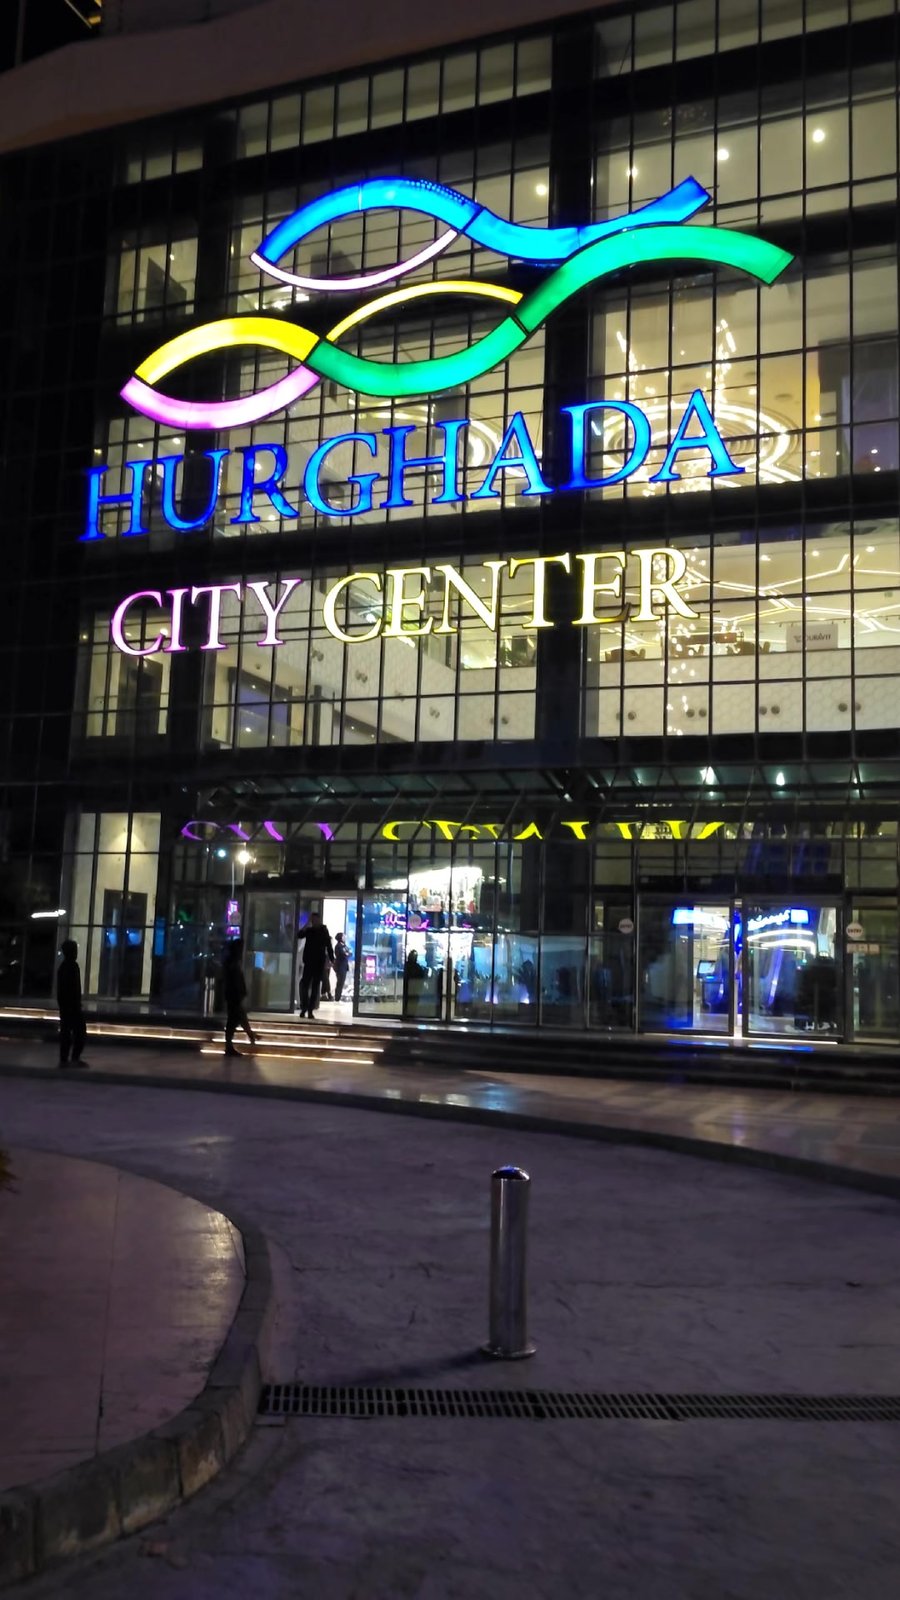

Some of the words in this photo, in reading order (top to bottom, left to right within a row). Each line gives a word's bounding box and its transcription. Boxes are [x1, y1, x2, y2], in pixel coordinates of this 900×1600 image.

[78, 388, 746, 541] HURGHADA
[111, 578, 303, 656] CITY
[322, 548, 700, 643] CENTER
